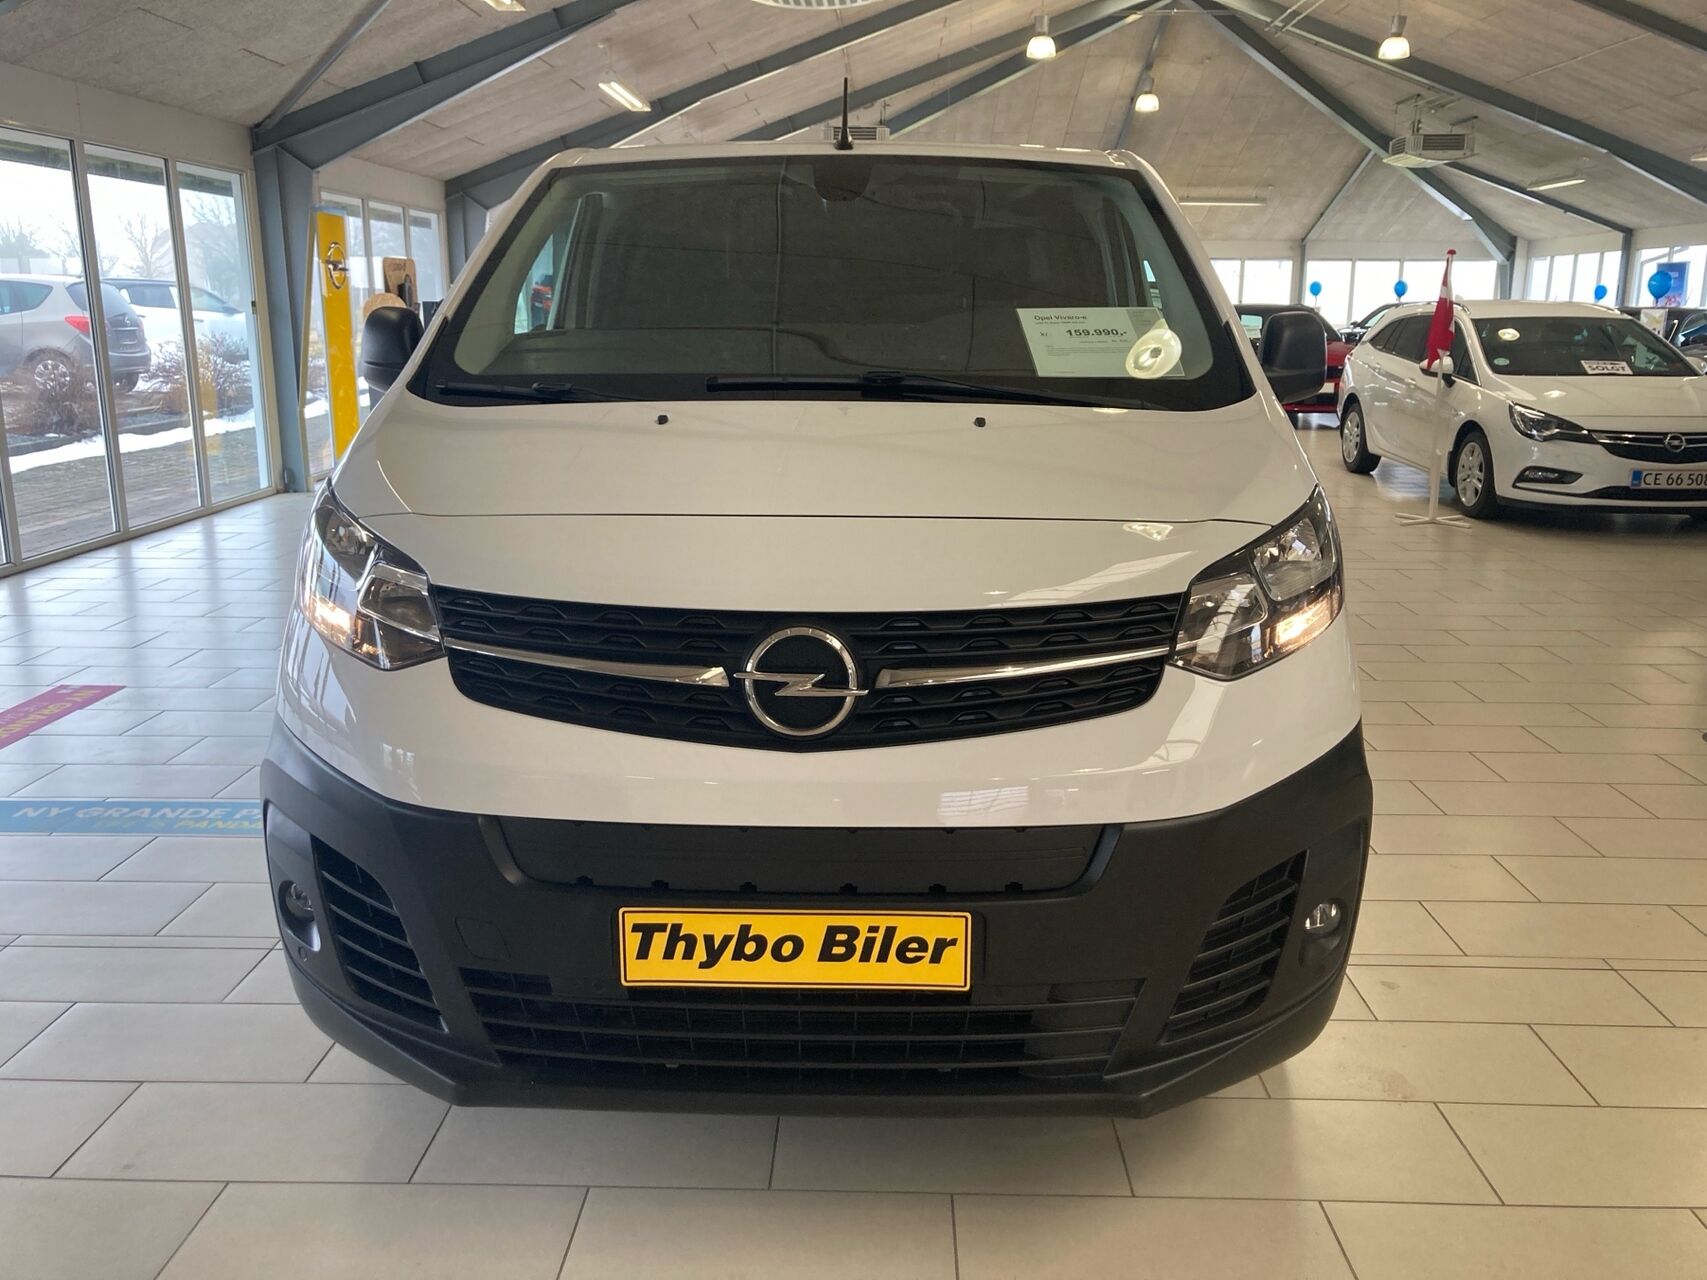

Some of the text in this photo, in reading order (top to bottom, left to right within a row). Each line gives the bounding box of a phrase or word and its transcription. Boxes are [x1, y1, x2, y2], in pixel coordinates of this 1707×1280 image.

[1065, 328, 1128, 337] 159.990,-
[1643, 474, 1663, 486] CE
[1666, 474, 1683, 486] 66
[13, 806, 74, 818] NY
[75, 806, 232, 819] GRANDE
[630, 922, 959, 970] Thybo Biler
